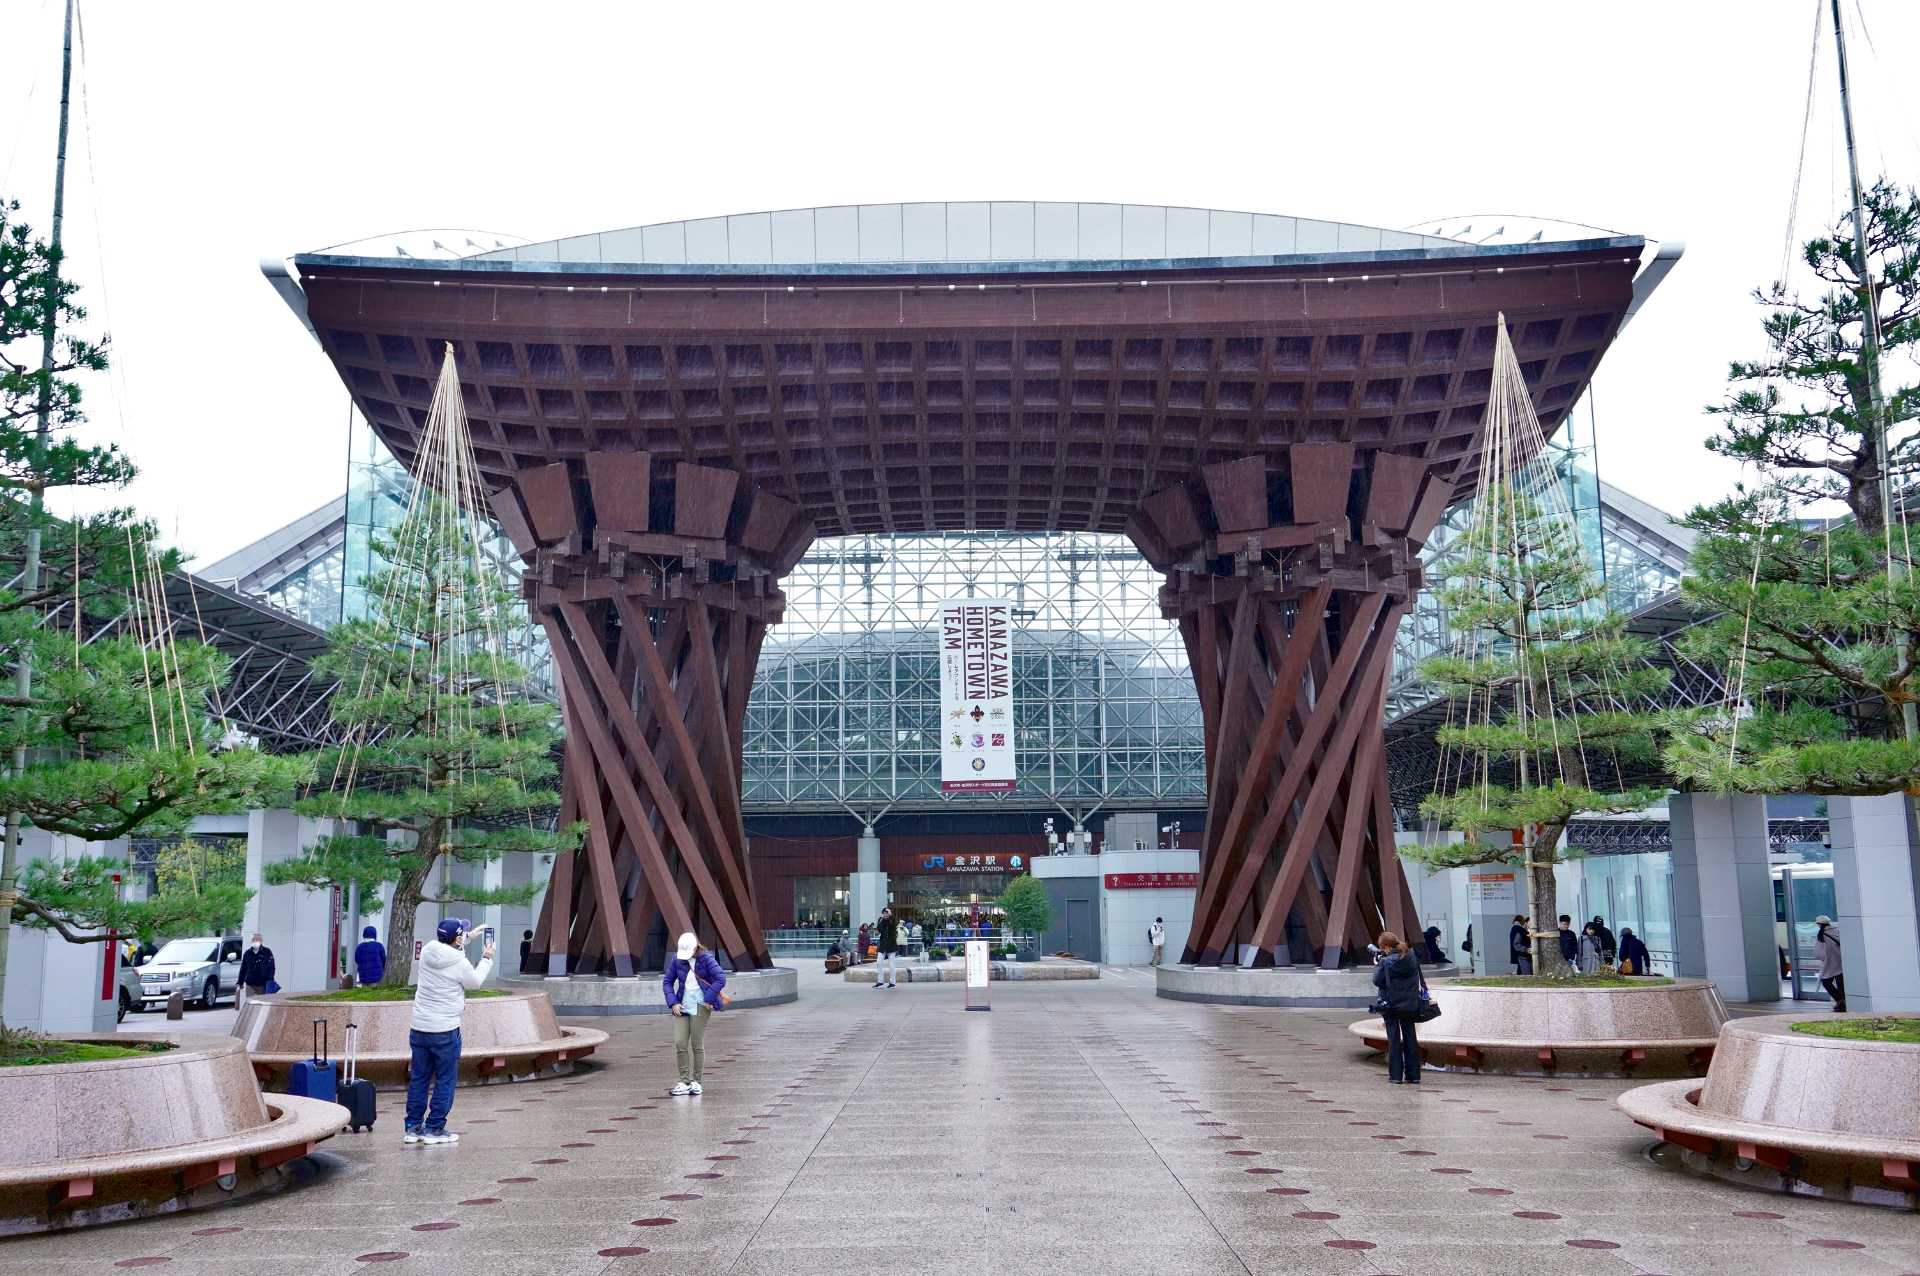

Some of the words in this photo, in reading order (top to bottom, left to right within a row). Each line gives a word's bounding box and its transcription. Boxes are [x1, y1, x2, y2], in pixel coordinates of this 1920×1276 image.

[944, 606, 961, 649] TEAM
[966, 606, 985, 699] HOMETOWN
[989, 606, 1008, 699] KANAZAWA
[923, 856, 945, 868] JR
[955, 855, 996, 866] 金沢駅
